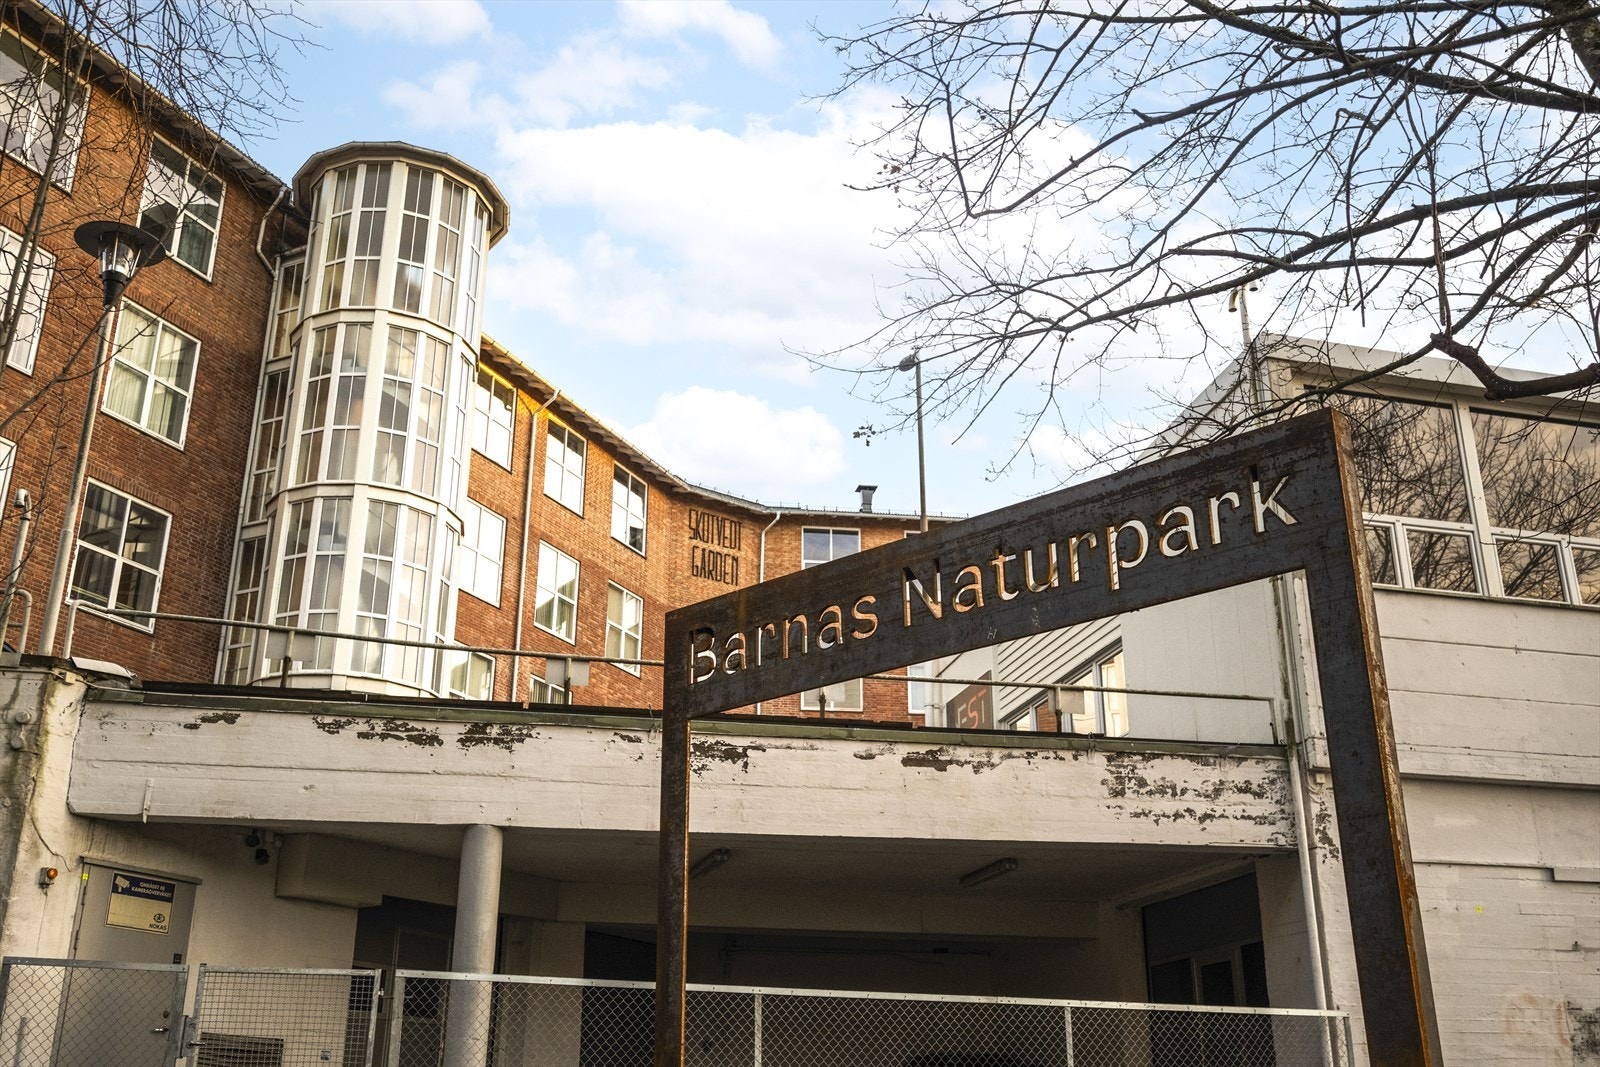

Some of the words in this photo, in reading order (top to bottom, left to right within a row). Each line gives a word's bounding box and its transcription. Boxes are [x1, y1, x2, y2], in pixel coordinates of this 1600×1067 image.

[689, 508, 742, 551] SKOTVEDT
[689, 595, 879, 686] Barnas
[902, 464, 1299, 627] Naturpark
